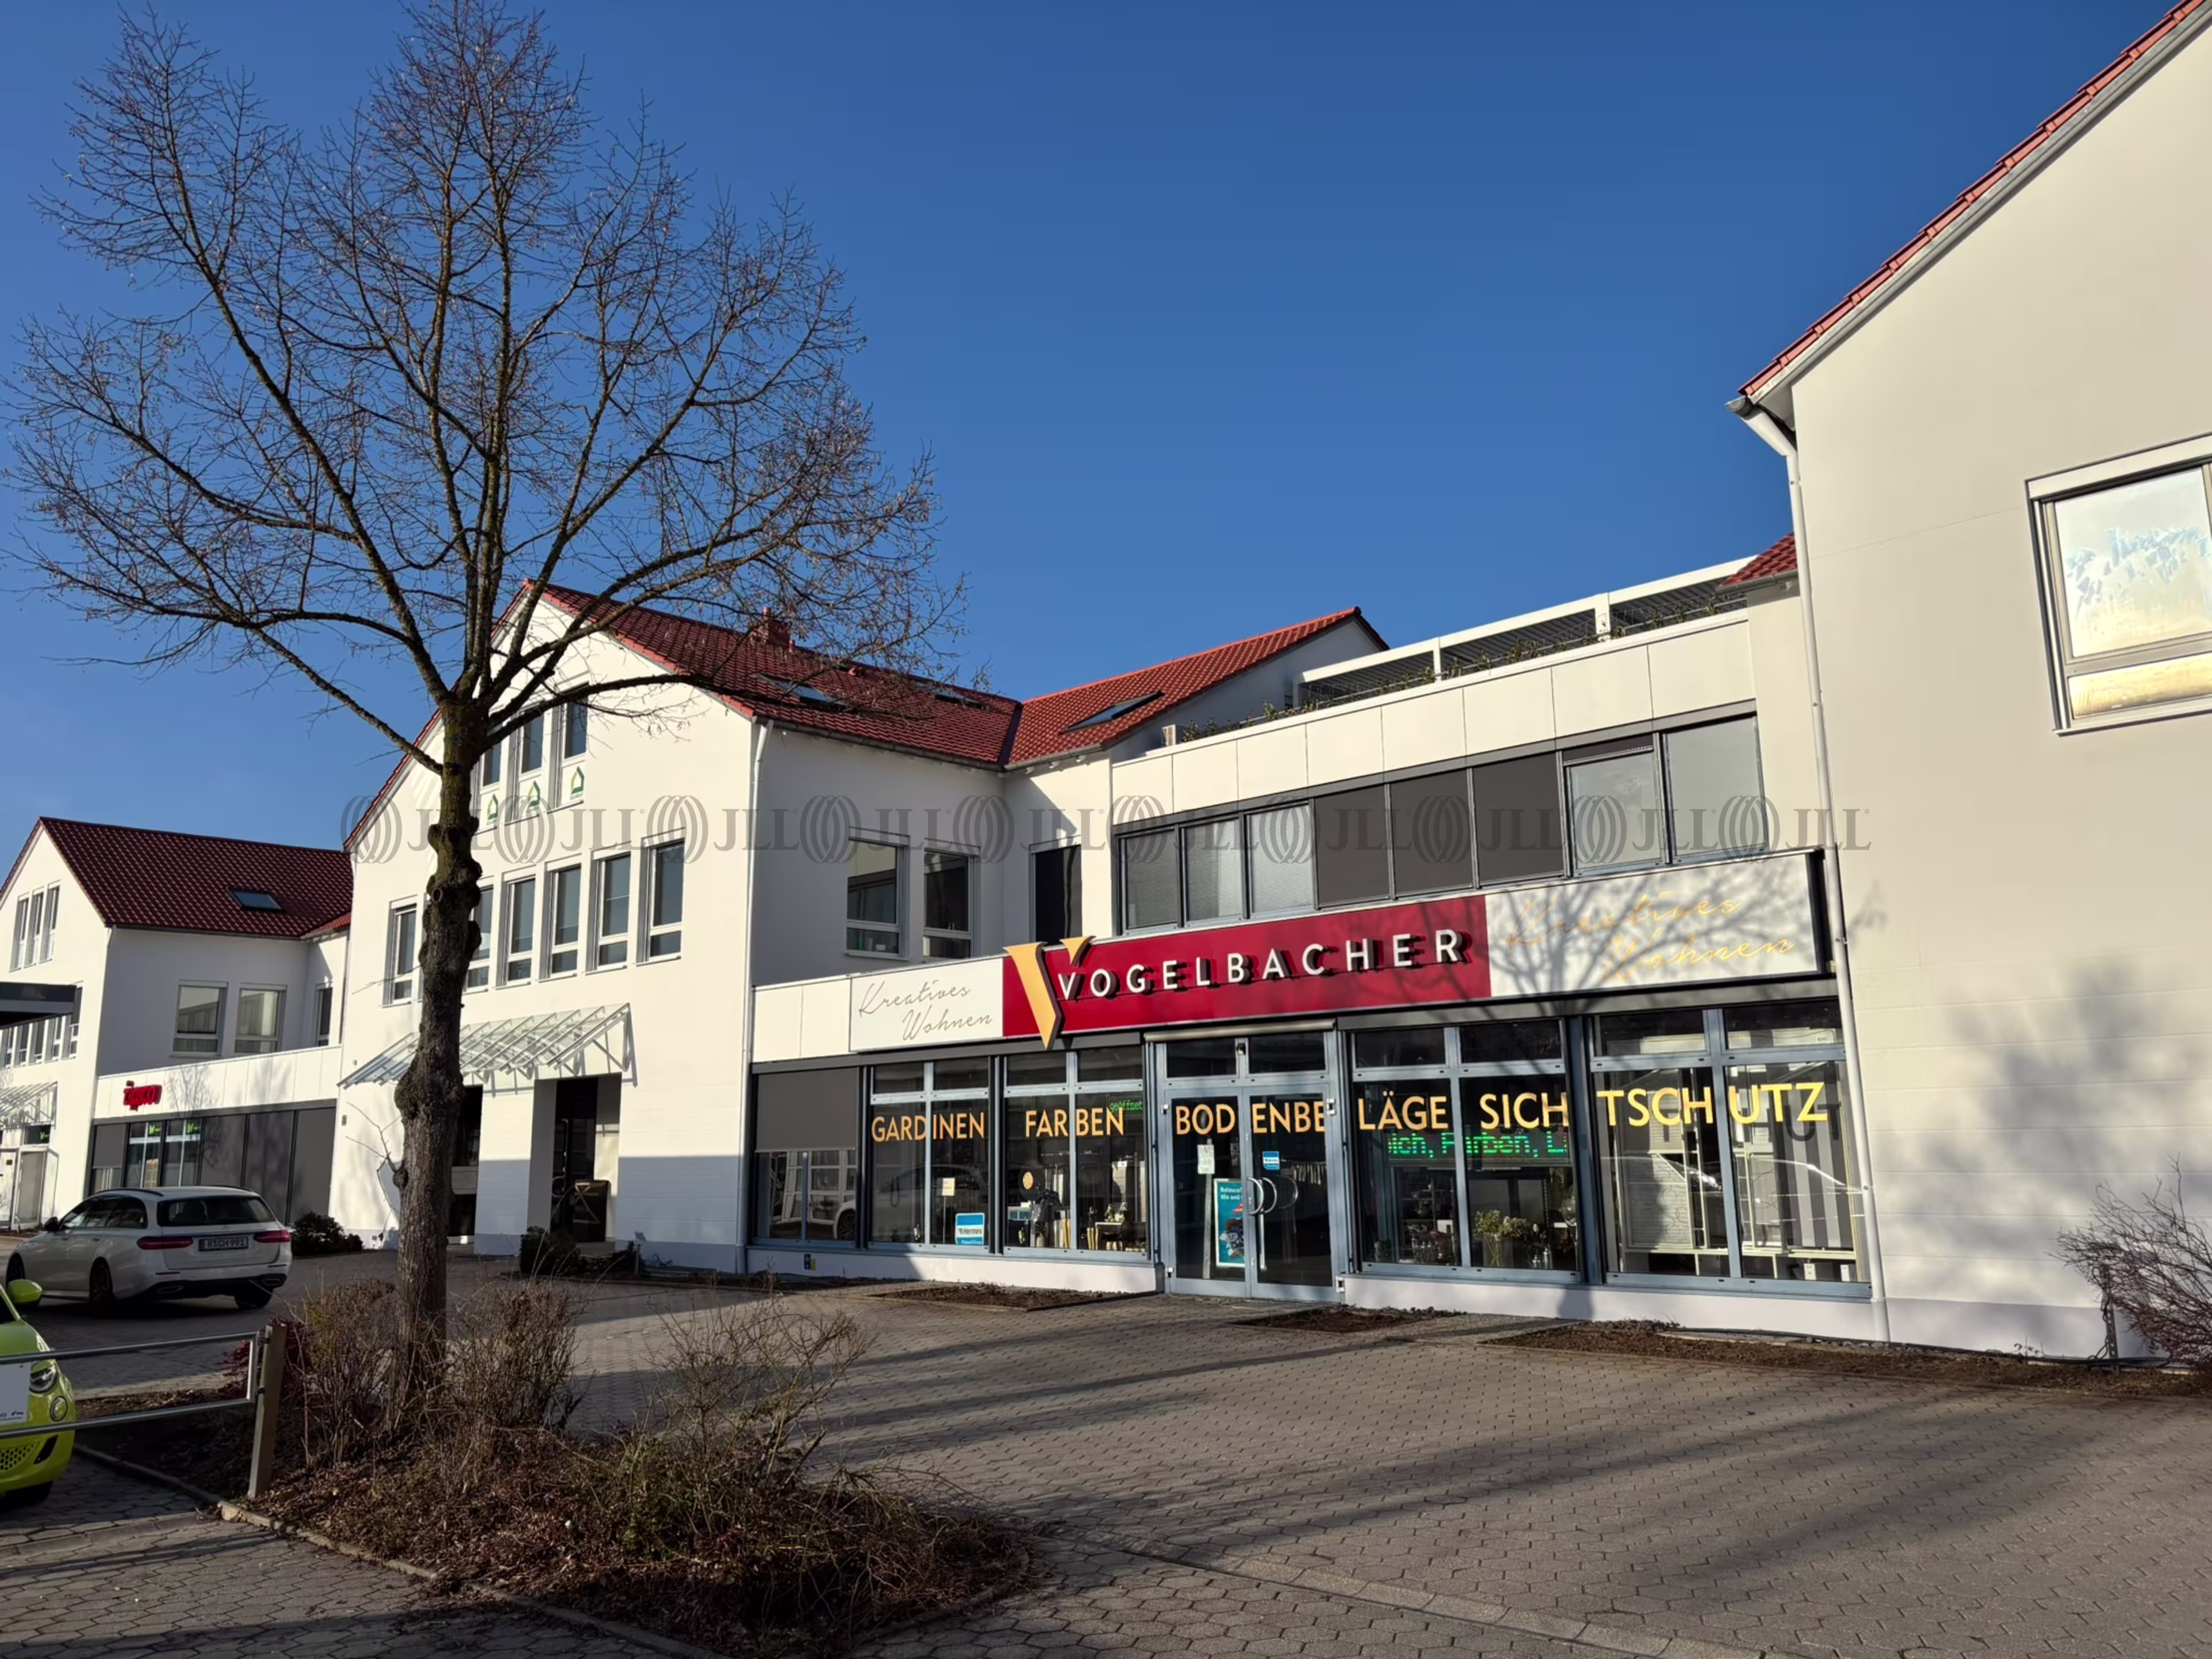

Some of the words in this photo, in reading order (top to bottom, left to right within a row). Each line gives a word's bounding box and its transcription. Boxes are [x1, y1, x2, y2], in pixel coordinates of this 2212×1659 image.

[1506, 891, 1742, 949] Kreatives
[1058, 929, 1464, 1001] VOGELBACHER
[1601, 927, 1796, 982] Wohnen
[858, 979, 972, 1018] Kreatives
[902, 1004, 993, 1041] Wohnen
[871, 1112, 985, 1142] GARDINEN
[1025, 1107, 1124, 1138] FARBEN
